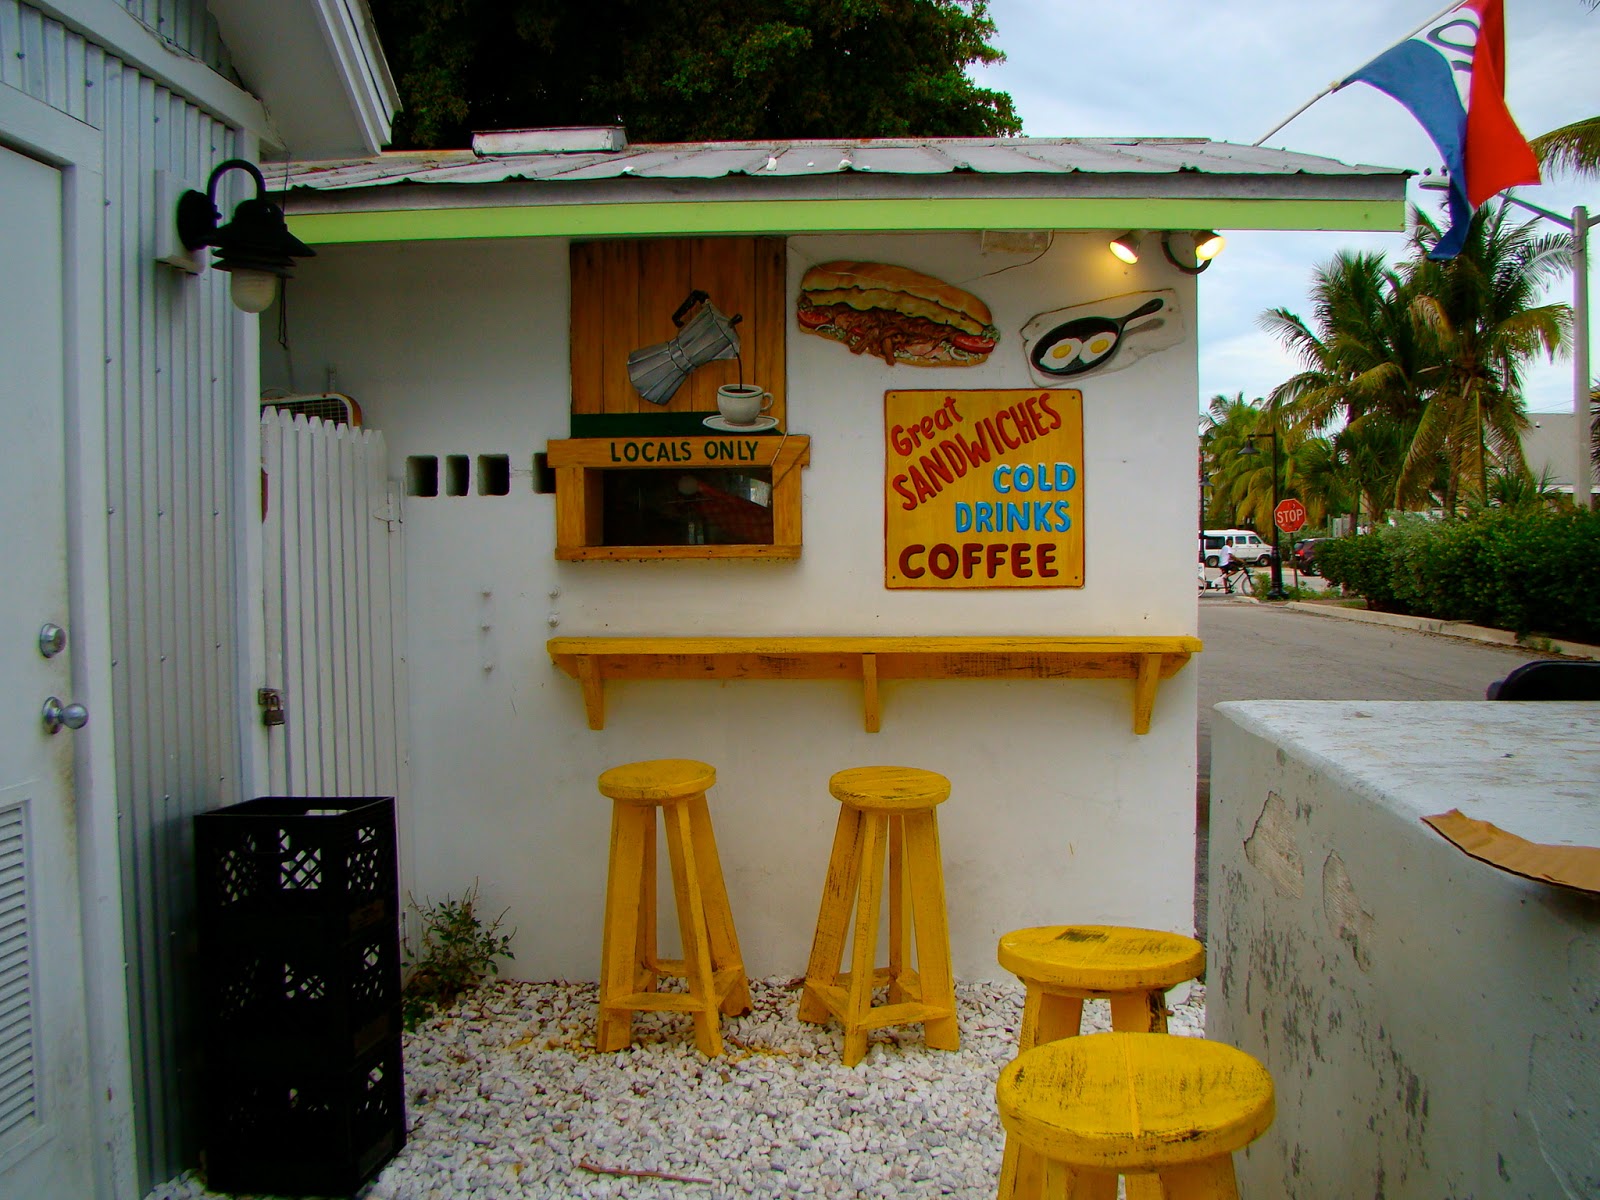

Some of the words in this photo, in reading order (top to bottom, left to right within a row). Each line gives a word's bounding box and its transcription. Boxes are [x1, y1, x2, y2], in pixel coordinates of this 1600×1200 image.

[891, 396, 963, 456] Great
[610, 442, 692, 462] LOCALS
[704, 441, 758, 461] ONLY
[892, 393, 1062, 511] SANDWICHES
[993, 462, 1076, 494] COLD
[955, 500, 1072, 533] DRINKS
[1277, 508, 1303, 524] STOP
[898, 542, 1059, 580] COFFEE
